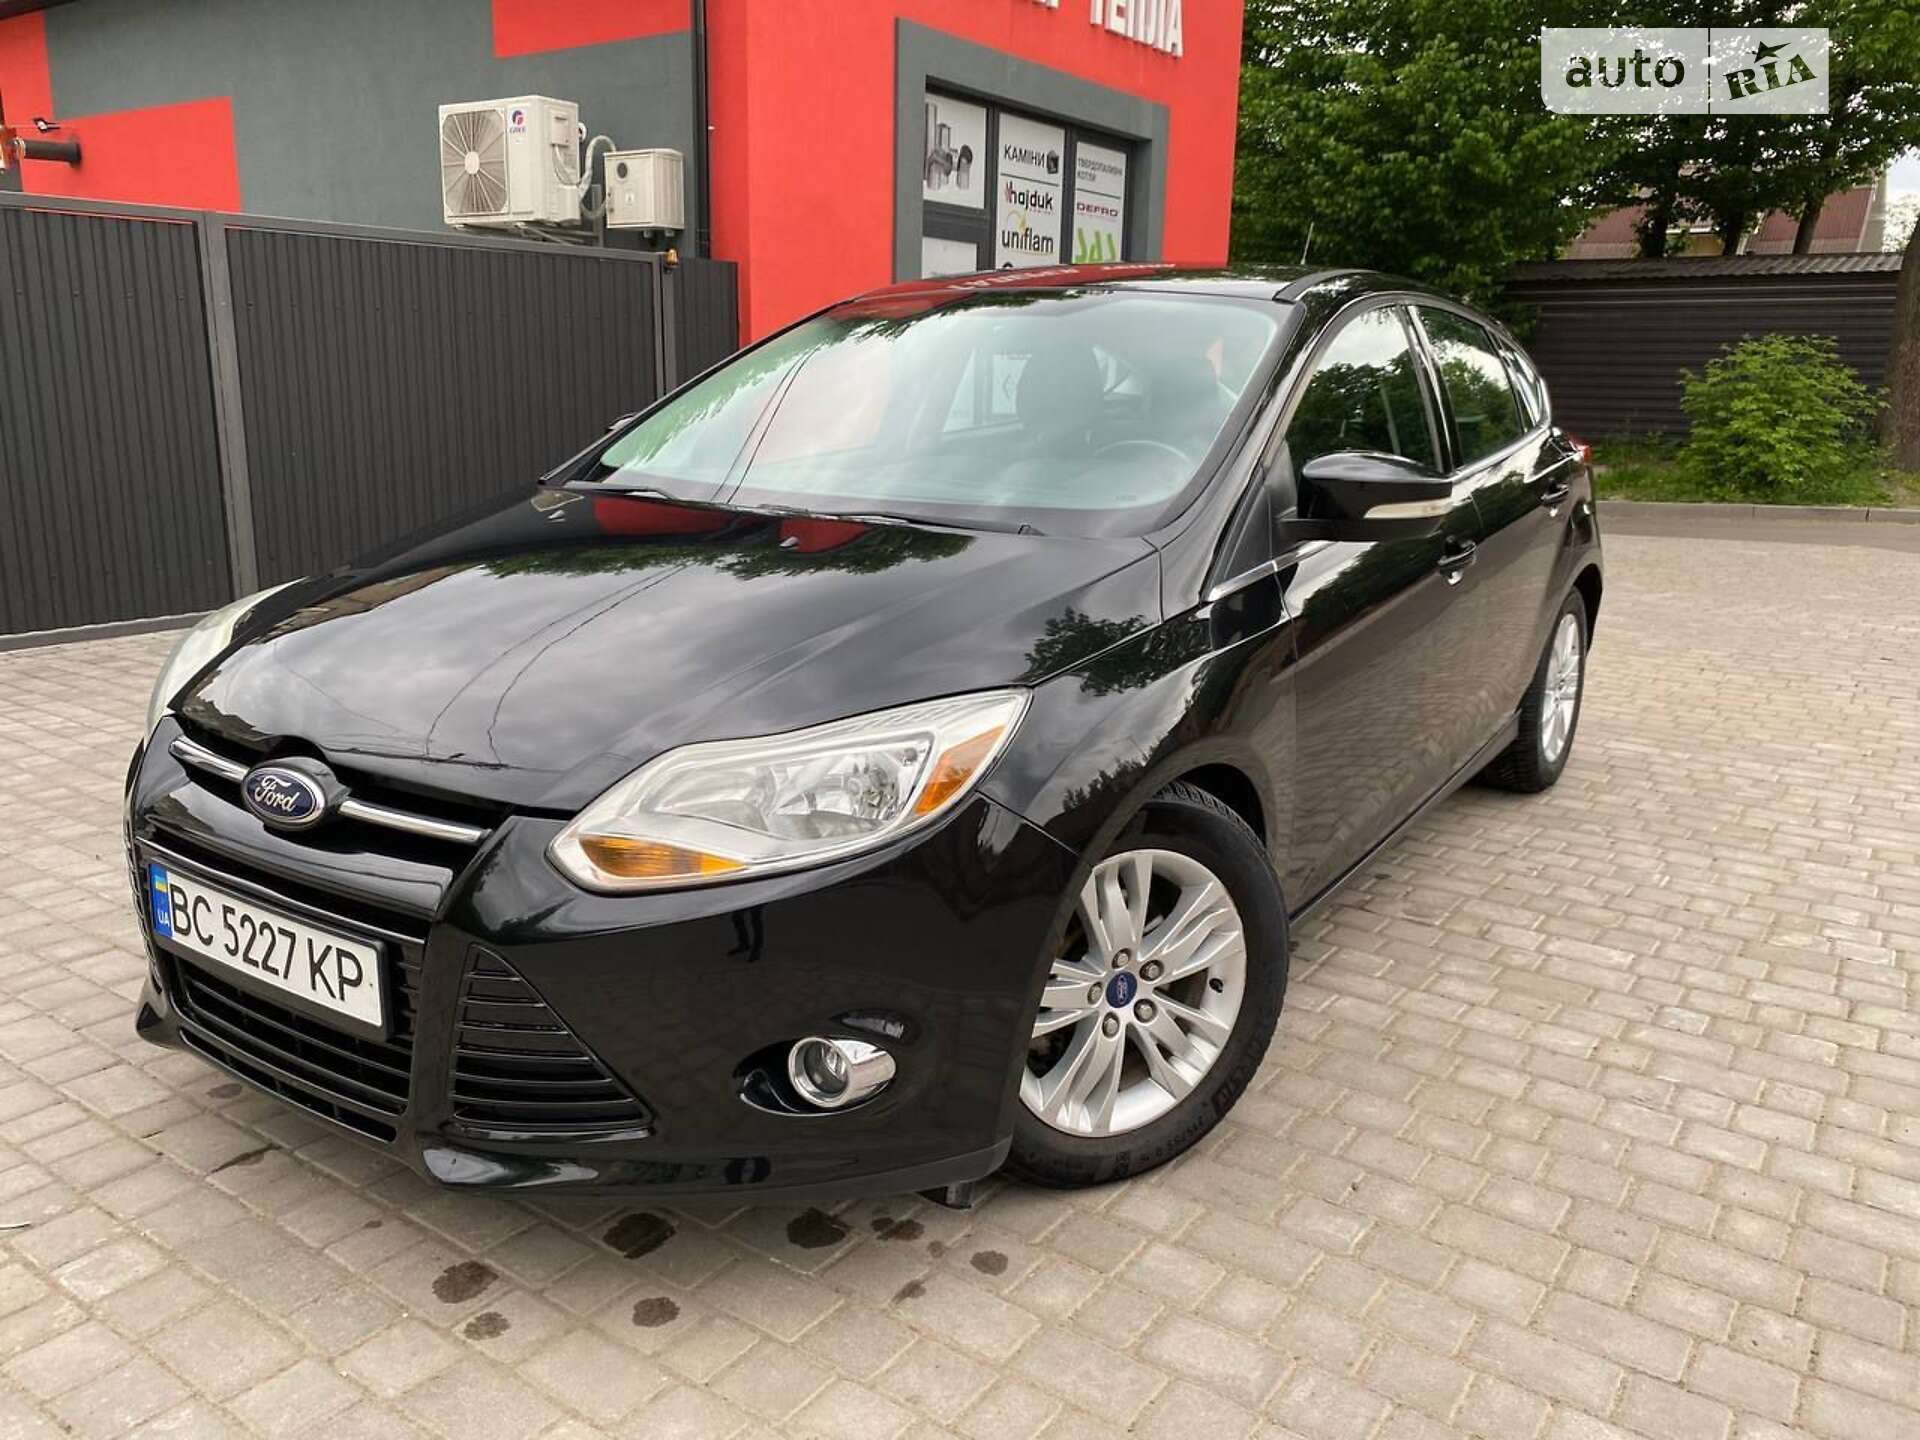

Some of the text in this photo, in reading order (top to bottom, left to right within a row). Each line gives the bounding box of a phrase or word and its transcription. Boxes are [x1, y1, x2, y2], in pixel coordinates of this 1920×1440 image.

[1004, 144, 1045, 168] КАМІНИ
[1006, 181, 1053, 211] hajduk
[1001, 227, 1054, 253] uniflam
[255, 775, 300, 812] Ford
[158, 910, 170, 927] UA
[169, 884, 364, 1001] BC 5227 KP
